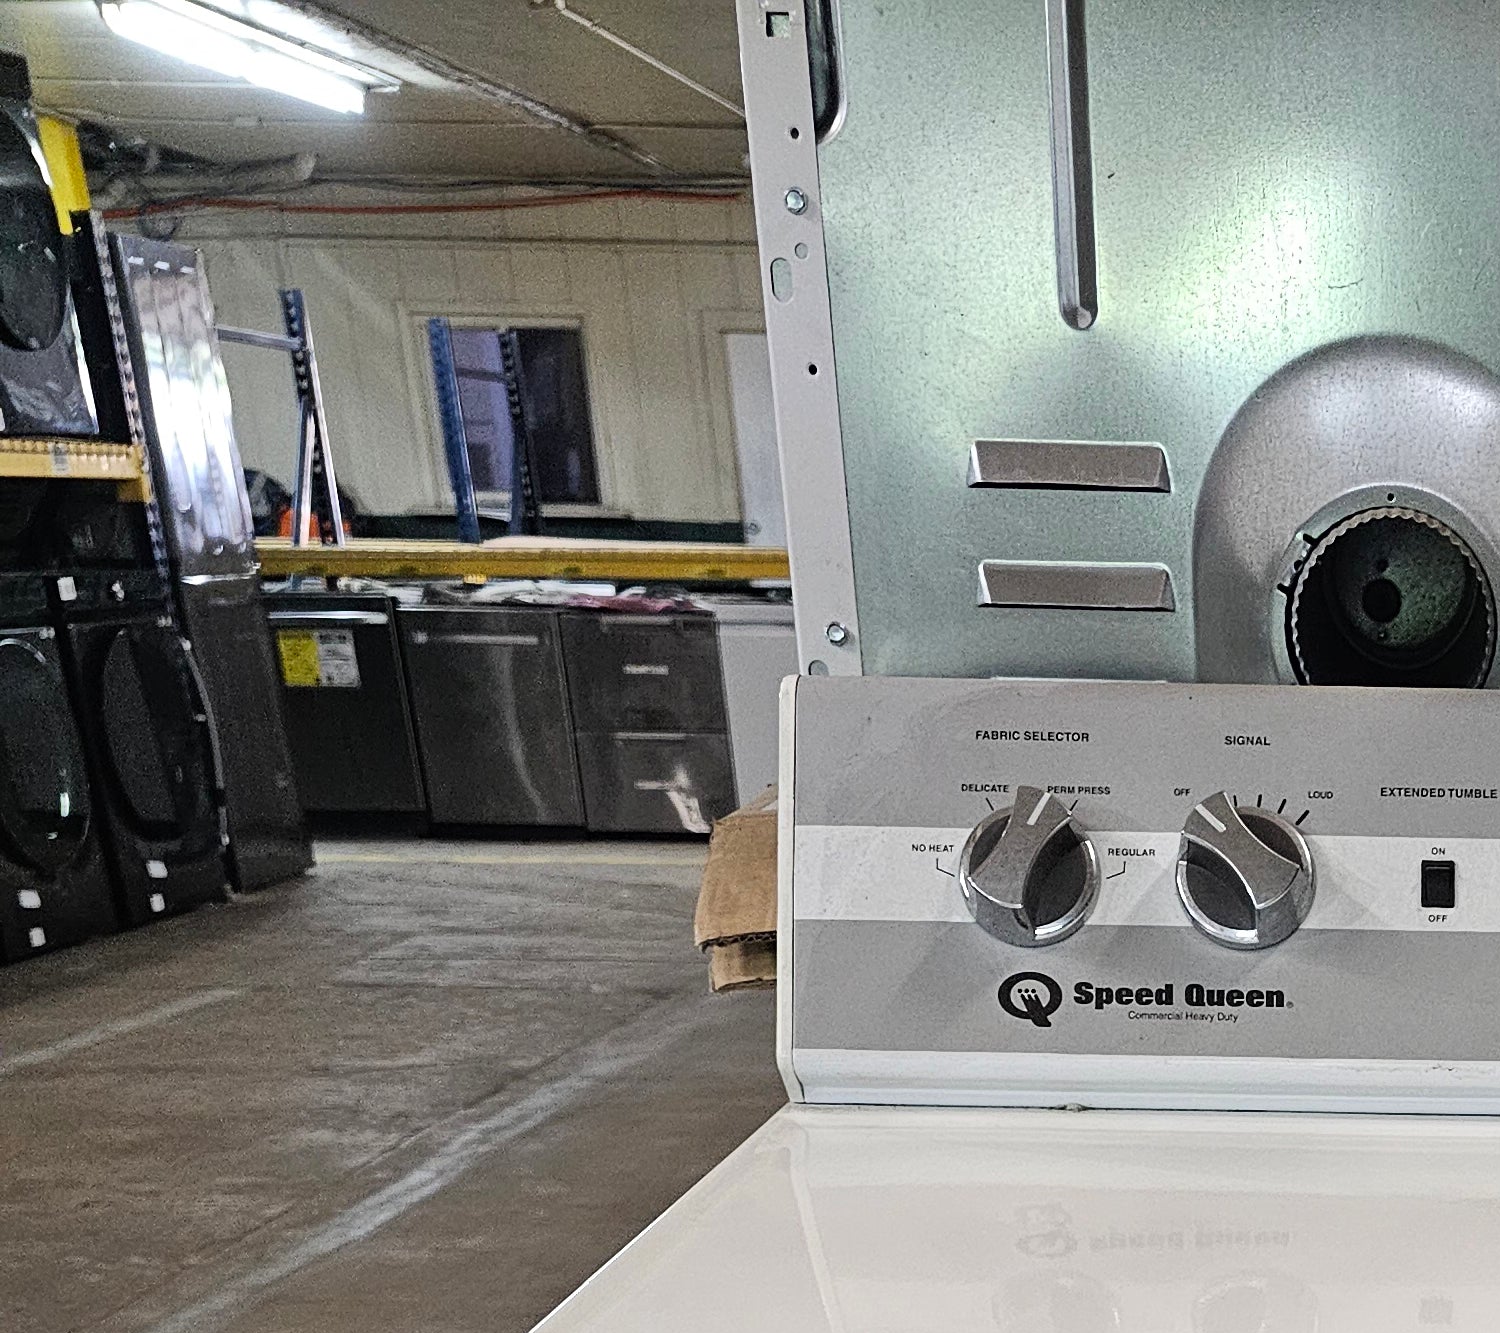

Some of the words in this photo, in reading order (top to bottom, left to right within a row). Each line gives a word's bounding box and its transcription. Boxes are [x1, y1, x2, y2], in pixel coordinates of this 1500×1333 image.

[975, 730, 1020, 741] FABRIC
[1024, 731, 1090, 742] SELECTOR
[1224, 735, 1271, 746] SIGNAL
[961, 783, 1010, 794] DELICATE
[1047, 785, 1076, 795] PERM
[1078, 786, 1111, 796] PRESS
[1173, 787, 1191, 797] OFF
[1380, 787, 1446, 798] EXTENDED
[1448, 788, 1498, 799] TUMBLE
[1308, 790, 1334, 800] LOUD
[911, 844, 924, 853] NO
[926, 844, 954, 853] HEAT
[1108, 847, 1156, 857] REGULAR
[1431, 847, 1446, 856] ON
[1428, 914, 1448, 923] OFF
[1073, 982, 1174, 1011] Speed
[1184, 983, 1286, 1009] Queen
[1128, 1010, 1183, 1022] Commercial
[1185, 1011, 1215, 1024] Heavy
[1217, 1012, 1239, 1024] Duty
